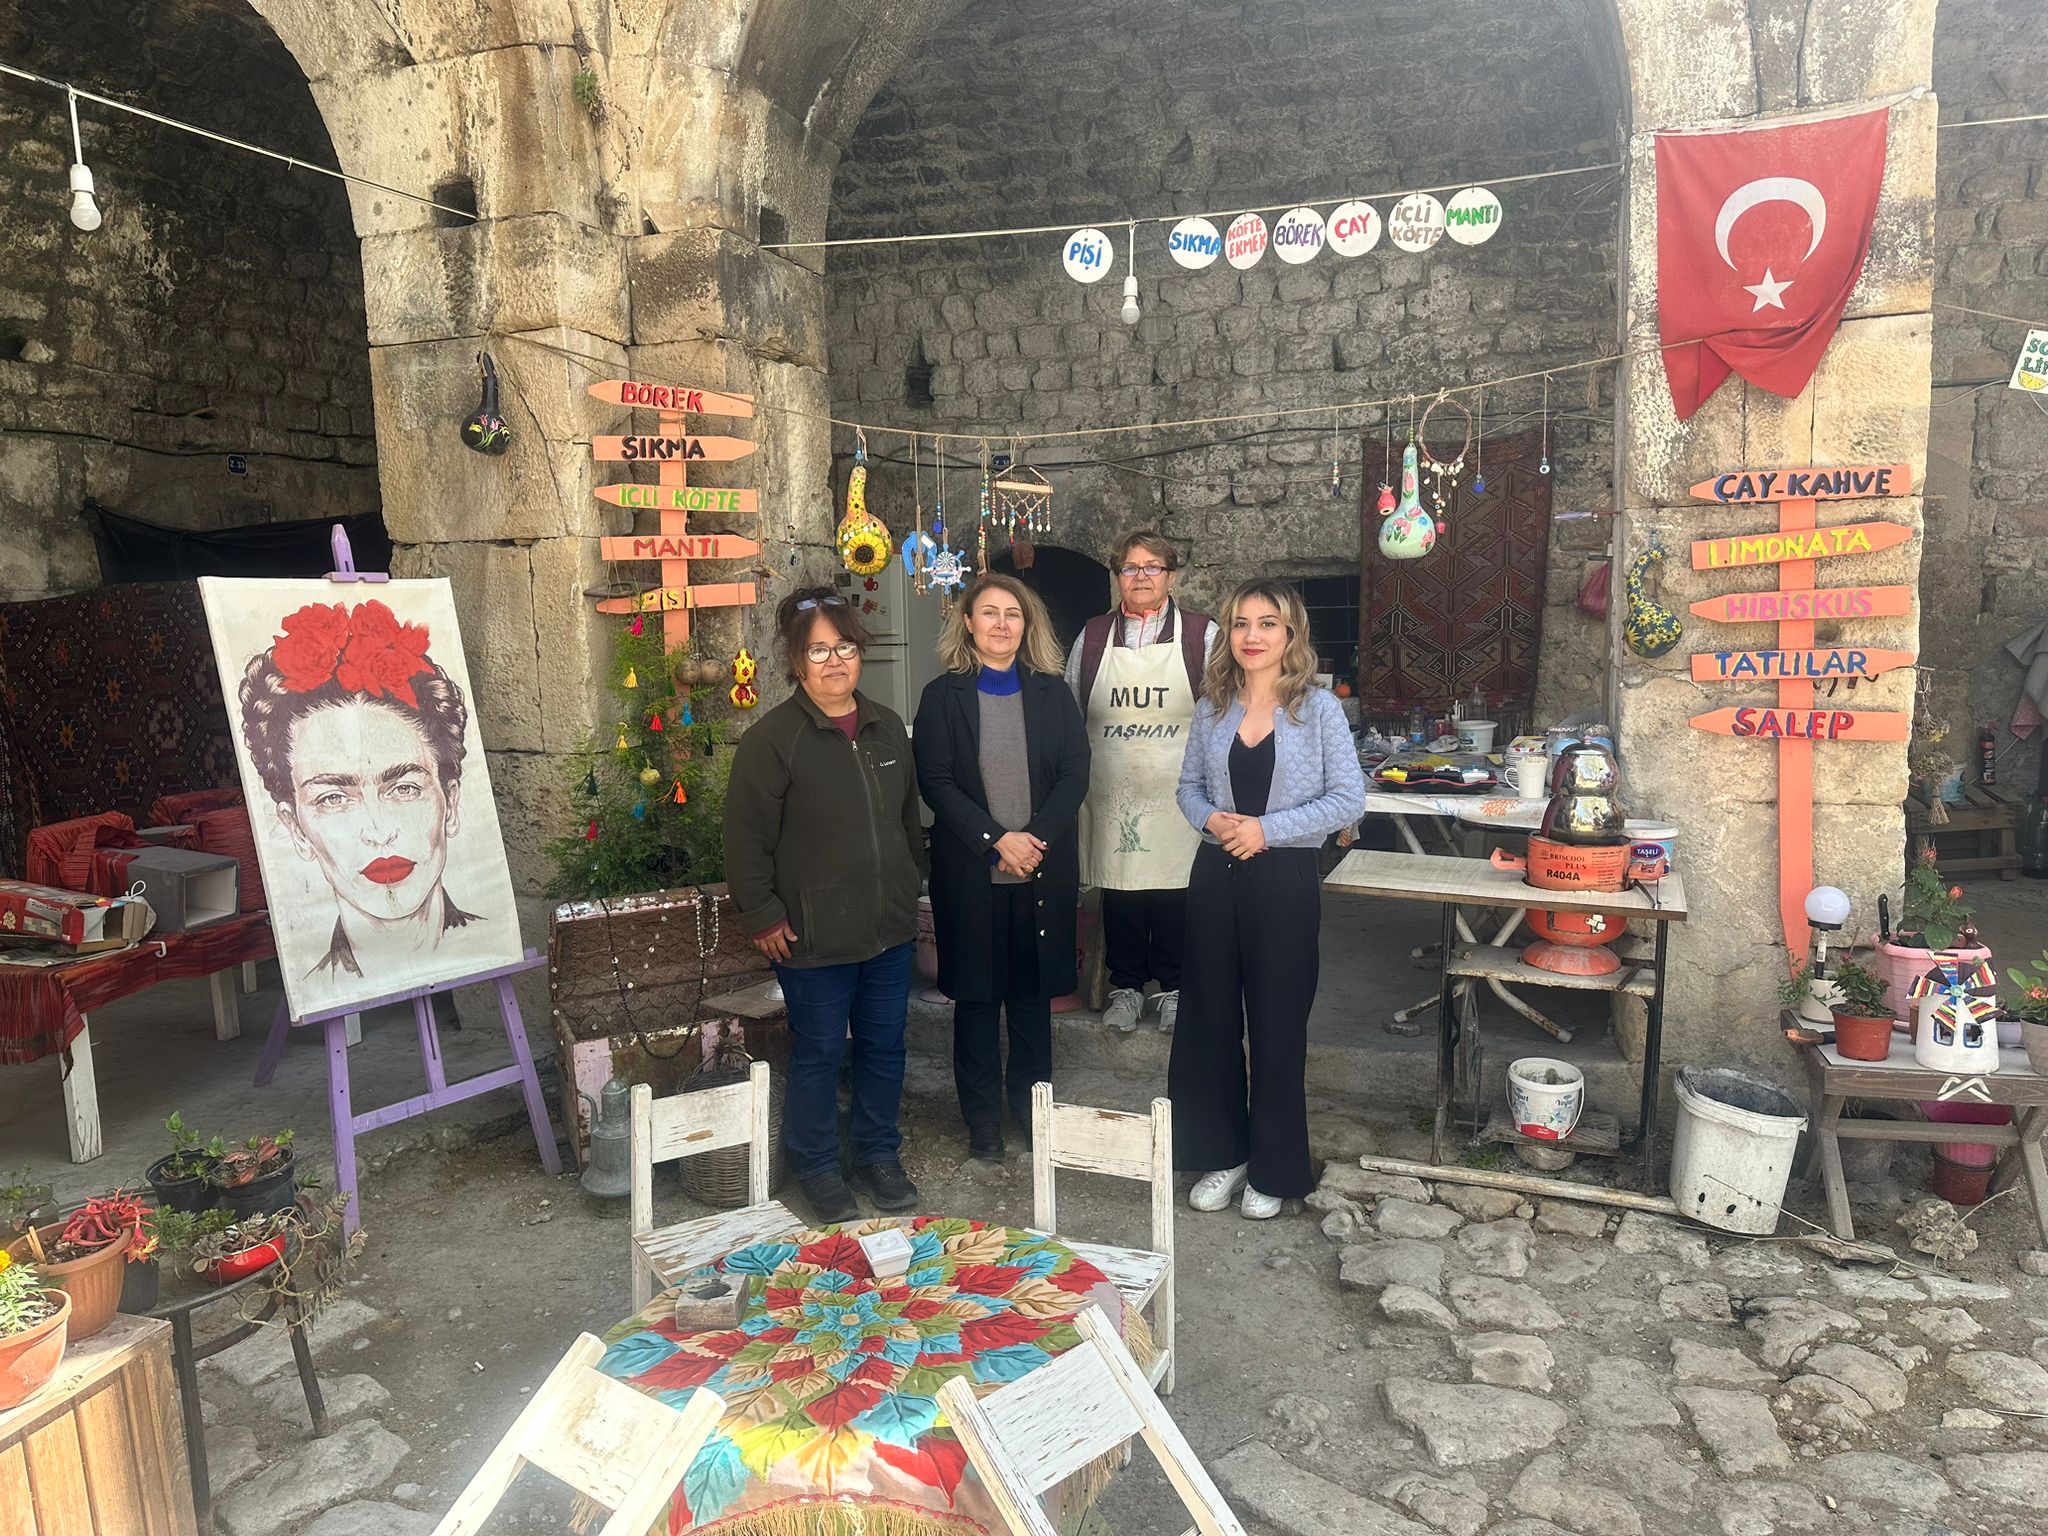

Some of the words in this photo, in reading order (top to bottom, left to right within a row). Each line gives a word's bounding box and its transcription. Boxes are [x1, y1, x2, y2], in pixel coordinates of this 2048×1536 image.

[1395, 200, 1431, 225] İÇLİ
[1446, 205, 1499, 226] MANTI
[1228, 217, 1262, 241] KÖFTE
[1275, 218, 1324, 247] BÖREK
[1334, 212, 1370, 242] ÇAY
[1392, 225, 1443, 246] KÖFTE
[1069, 237, 1103, 270] PİŞİ
[1169, 232, 1221, 255] SIKMA
[1229, 233, 1267, 260] EKMEK
[620, 382, 704, 414] BÖREK
[621, 435, 706, 460] SIKMA
[673, 487, 741, 511] KÖFTE
[633, 537, 719, 558] MANTI
[1708, 528, 1872, 566] LİMONATA
[1715, 651, 1868, 678] TATLILAR
[1110, 686, 1170, 709] MUT
[1103, 723, 1181, 741] TAŞHAN
[1731, 707, 1855, 739] SALEP
[1546, 868, 1581, 881] R404A
